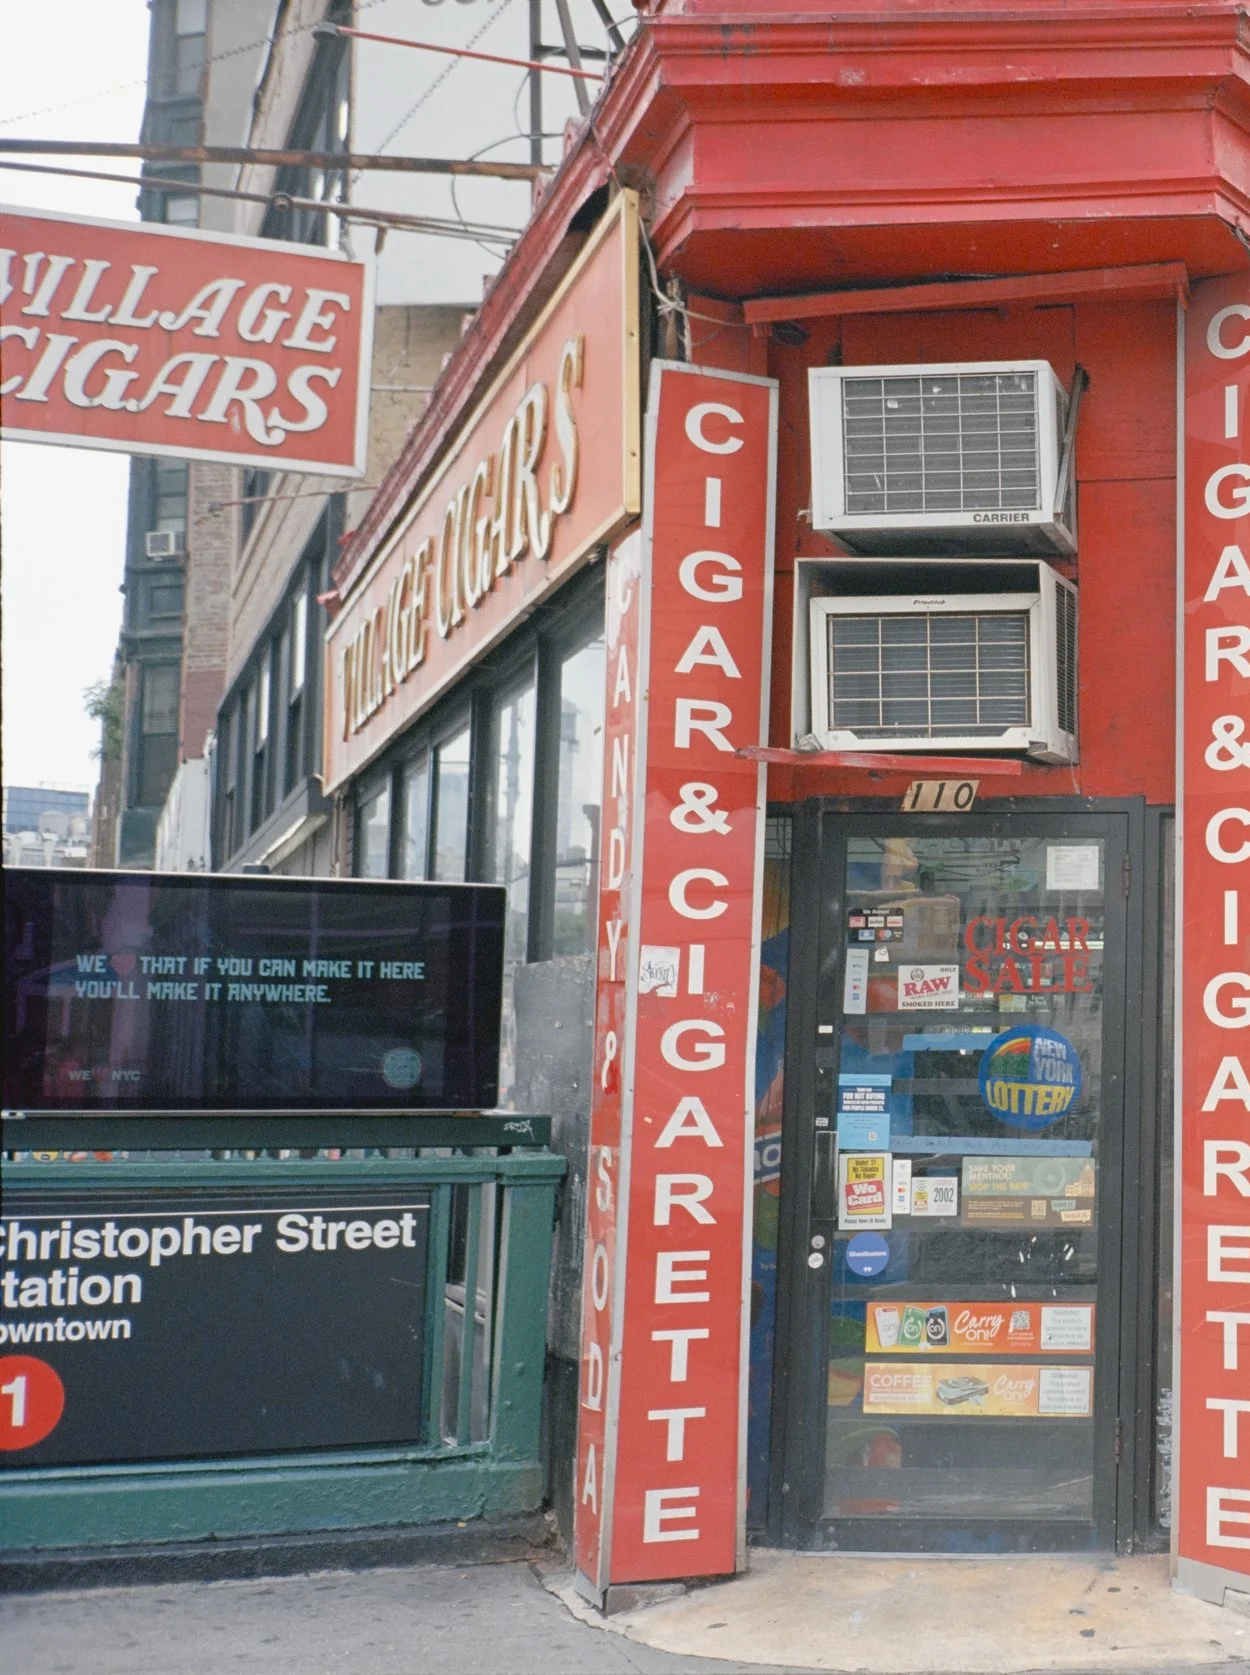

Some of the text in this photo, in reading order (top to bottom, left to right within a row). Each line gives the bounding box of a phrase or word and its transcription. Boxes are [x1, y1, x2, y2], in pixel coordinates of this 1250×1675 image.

[973, 513, 1030, 523] CARRIER
[338, 332, 586, 742] VILLAGE CIGARS
[910, 782, 974, 809] 110
[964, 916, 1091, 954] CIGAR
[76, 955, 425, 980] WE THAT IF YOU CAN MAKE IT HERE
[963, 953, 1093, 993] SALE
[75, 981, 332, 1003] YOU'LL MAKE IT ANYWHERE.
[903, 976, 951, 997] RAW
[1034, 1037, 1067, 1060] NEW
[68, 1070, 141, 1081] WE NYC
[1034, 1058, 1073, 1083] YORK
[986, 1079, 1076, 1115] LOTTERY
[852, 1182, 877, 1195] We
[933, 1187, 954, 1203] 2002
[0, 1212, 418, 1266] hristopher Street
[0, 1266, 142, 1308] tation
[954, 1310, 1005, 1338] Carry
[871, 1374, 933, 1388] COFFEE
[0, 1376, 27, 1427] 1
